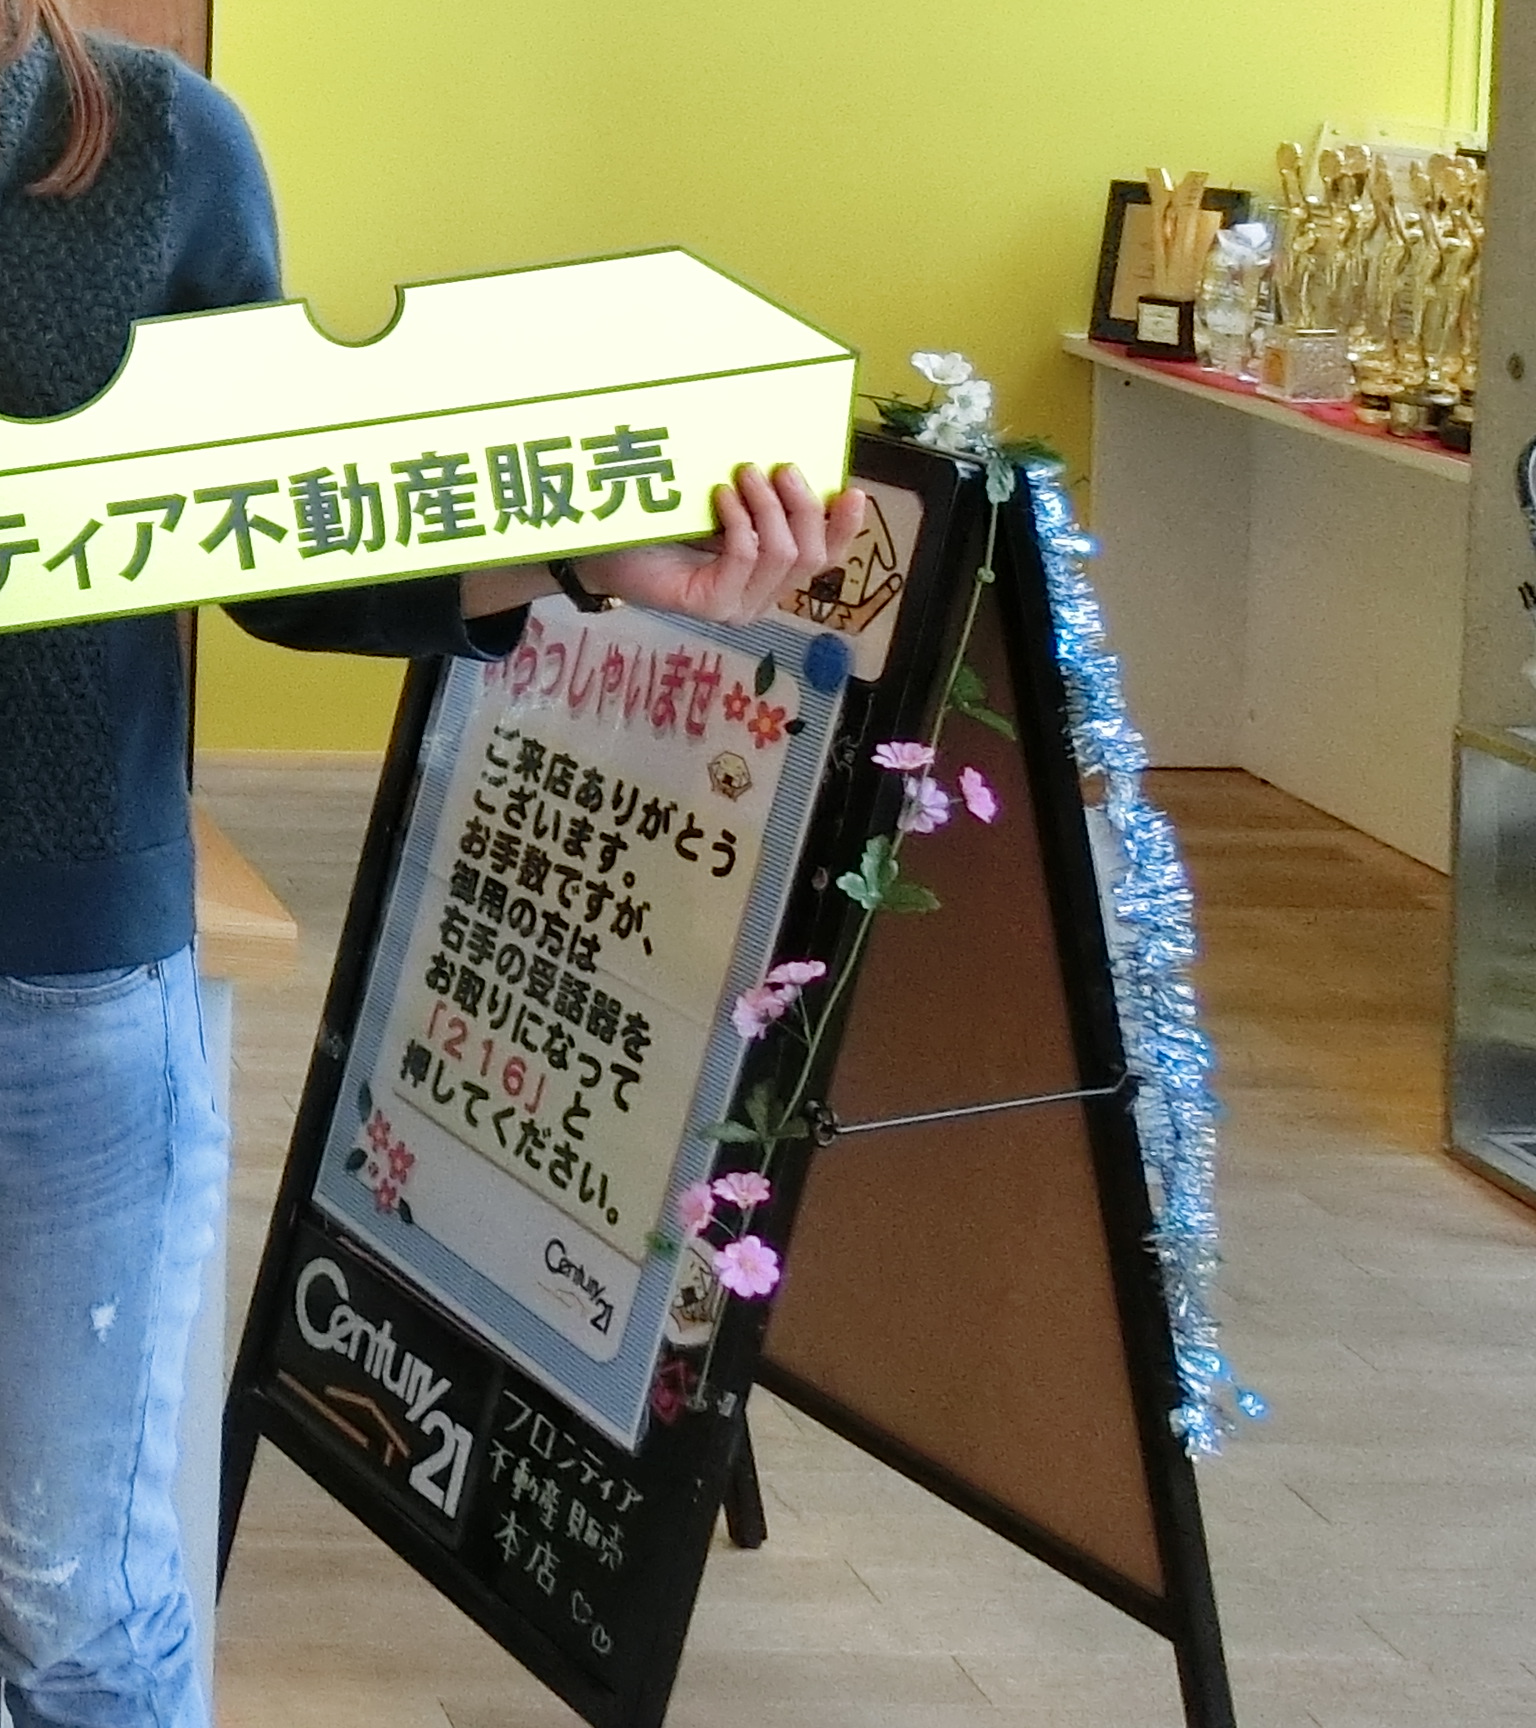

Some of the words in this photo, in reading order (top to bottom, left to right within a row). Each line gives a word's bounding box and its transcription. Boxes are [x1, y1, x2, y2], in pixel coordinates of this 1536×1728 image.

[473, 771, 636, 889] ございます。
[486, 725, 737, 877] ご来店ありがとう
[449, 858, 602, 973] 御用の方は
[460, 816, 653, 956] お手数ですが、
[425, 950, 641, 1113] お取りになって
[438, 904, 652, 1064] 右手の受話器を
[399, 1038, 619, 1226] 押してください。
[589, 1297, 615, 1336] 21
[295, 1256, 453, 1423] Century
[408, 1409, 475, 1519] 21
[501, 1388, 645, 1513] フロンティア
[487, 1437, 626, 1570] 不動産販売
[493, 1509, 562, 1596] 本店
